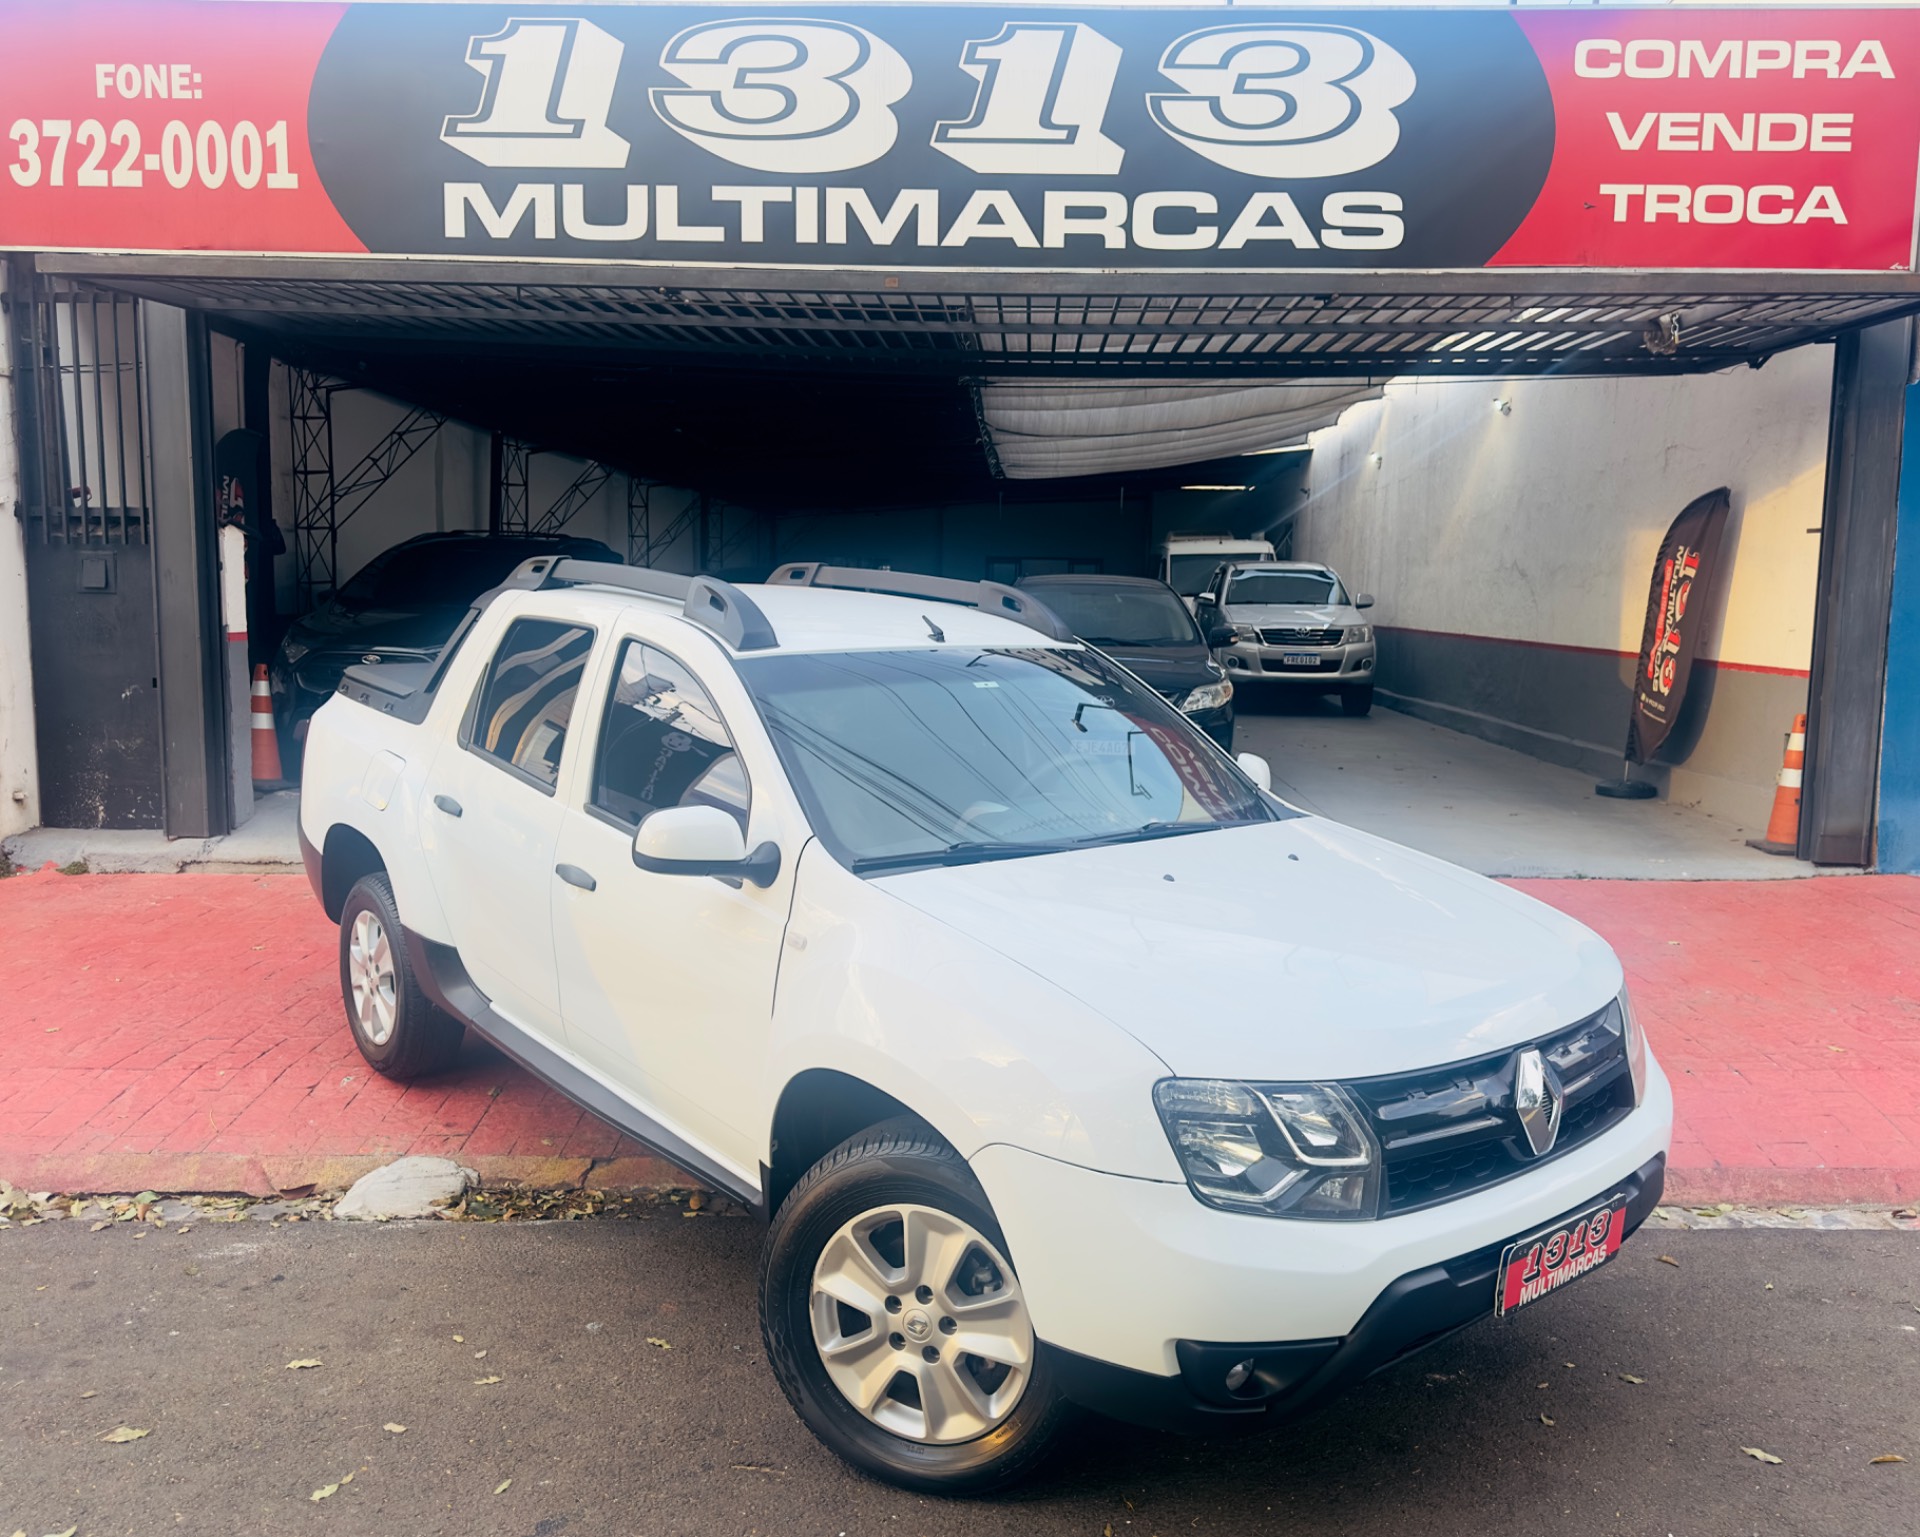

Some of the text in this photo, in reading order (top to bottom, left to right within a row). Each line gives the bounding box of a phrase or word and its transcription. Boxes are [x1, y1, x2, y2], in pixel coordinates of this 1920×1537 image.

[95, 63, 204, 99] FONE:
[1574, 38, 1896, 79] COMPRA
[440, 17, 1416, 179] 1313
[9, 119, 298, 189] 3722-0001
[1606, 112, 1854, 152] VENDE
[444, 182, 1404, 250] MULTIMARCAS
[1600, 184, 1848, 225] TROCA
[1519, 1244, 1607, 1307] MULTIMARCAS
[1522, 1209, 1613, 1285] 1313
